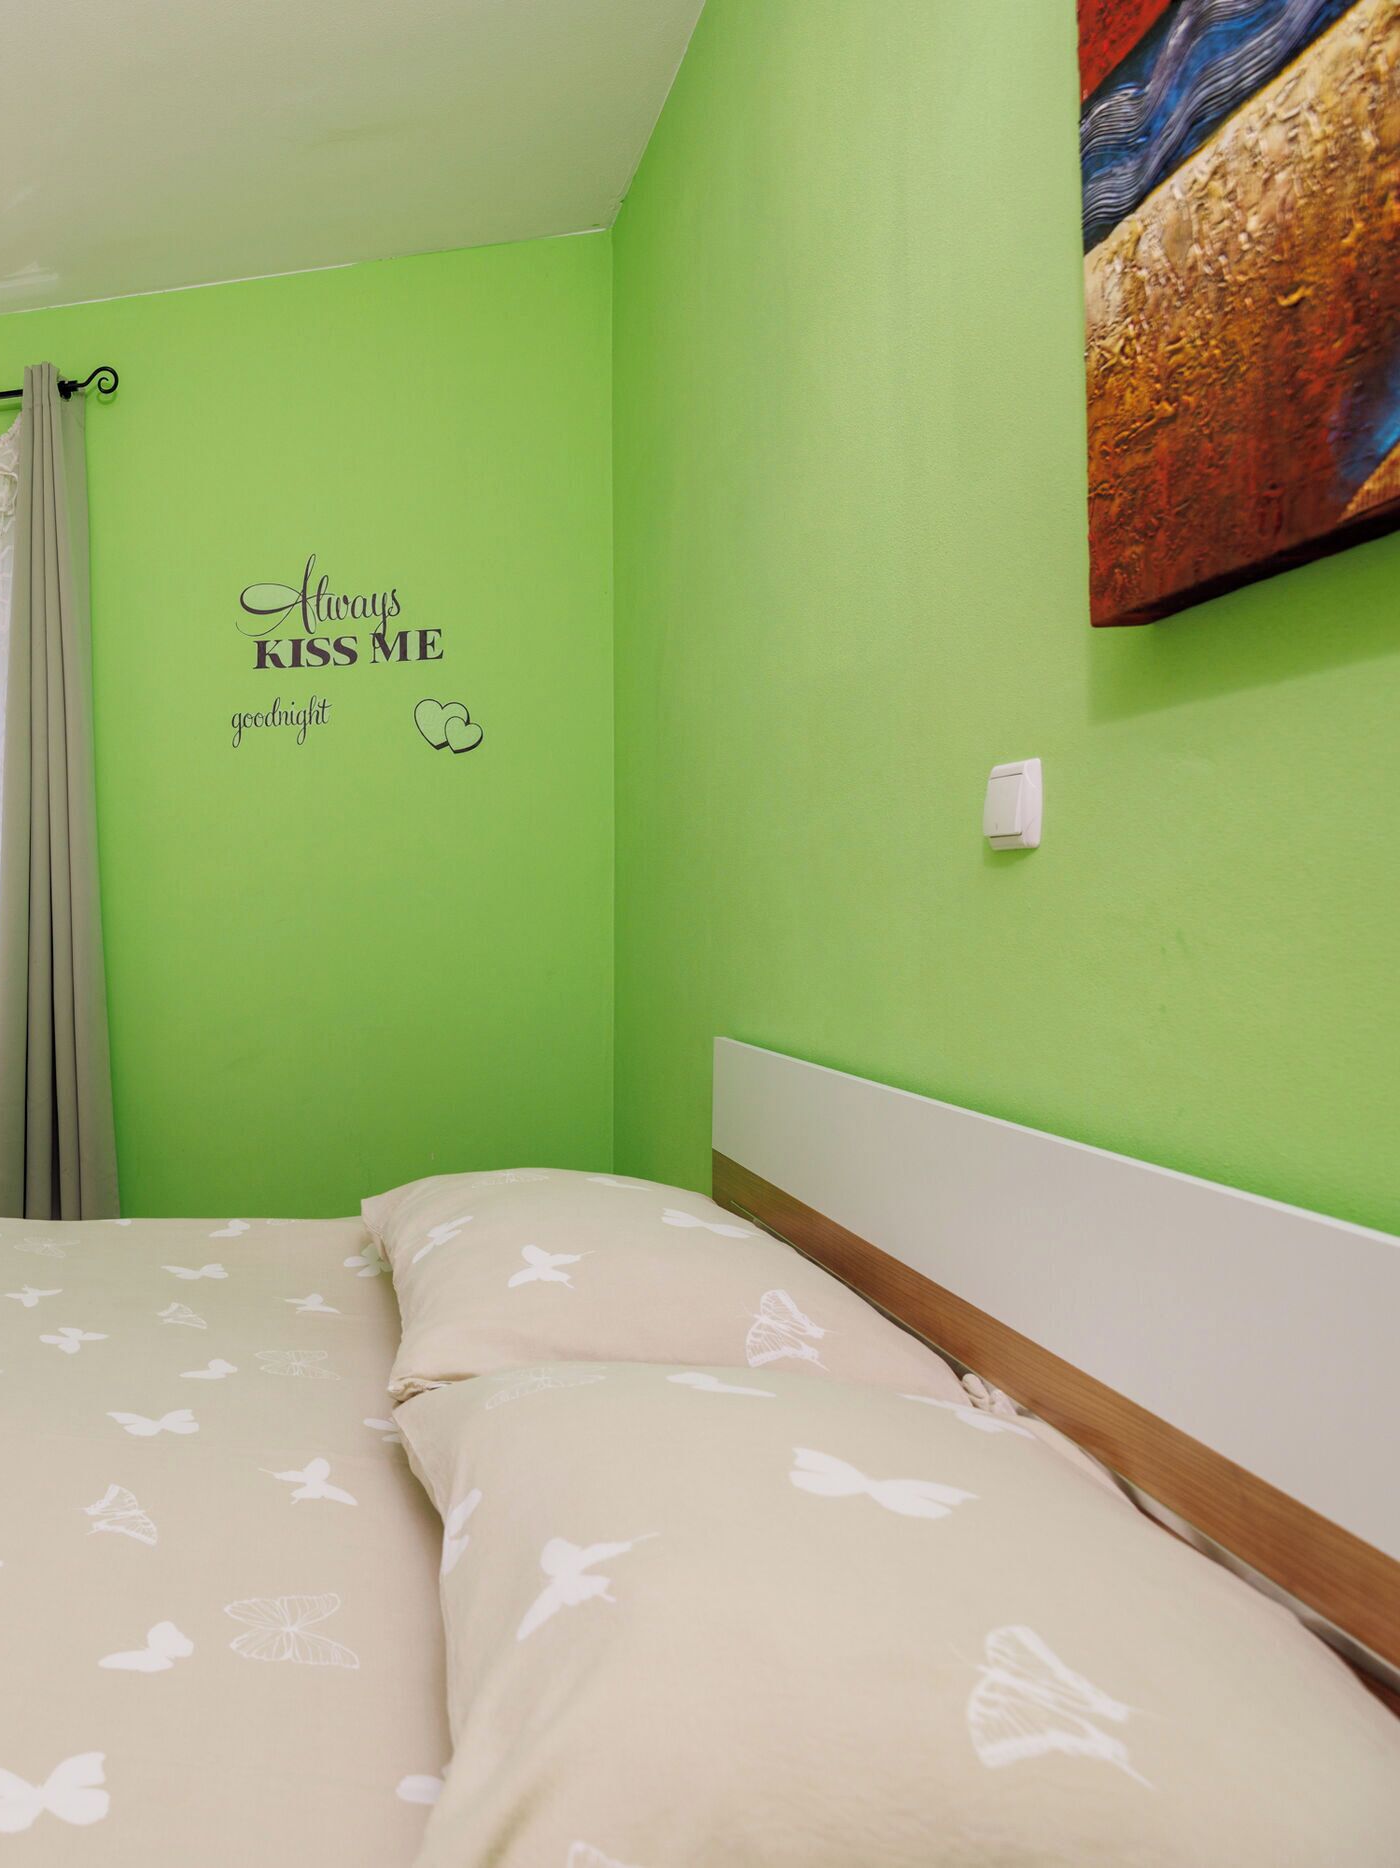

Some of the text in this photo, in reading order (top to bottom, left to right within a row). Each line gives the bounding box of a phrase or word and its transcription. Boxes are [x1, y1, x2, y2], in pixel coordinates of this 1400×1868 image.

[236, 553, 401, 649] Always
[252, 628, 444, 670] KISS ME
[231, 695, 333, 748] goodnight
